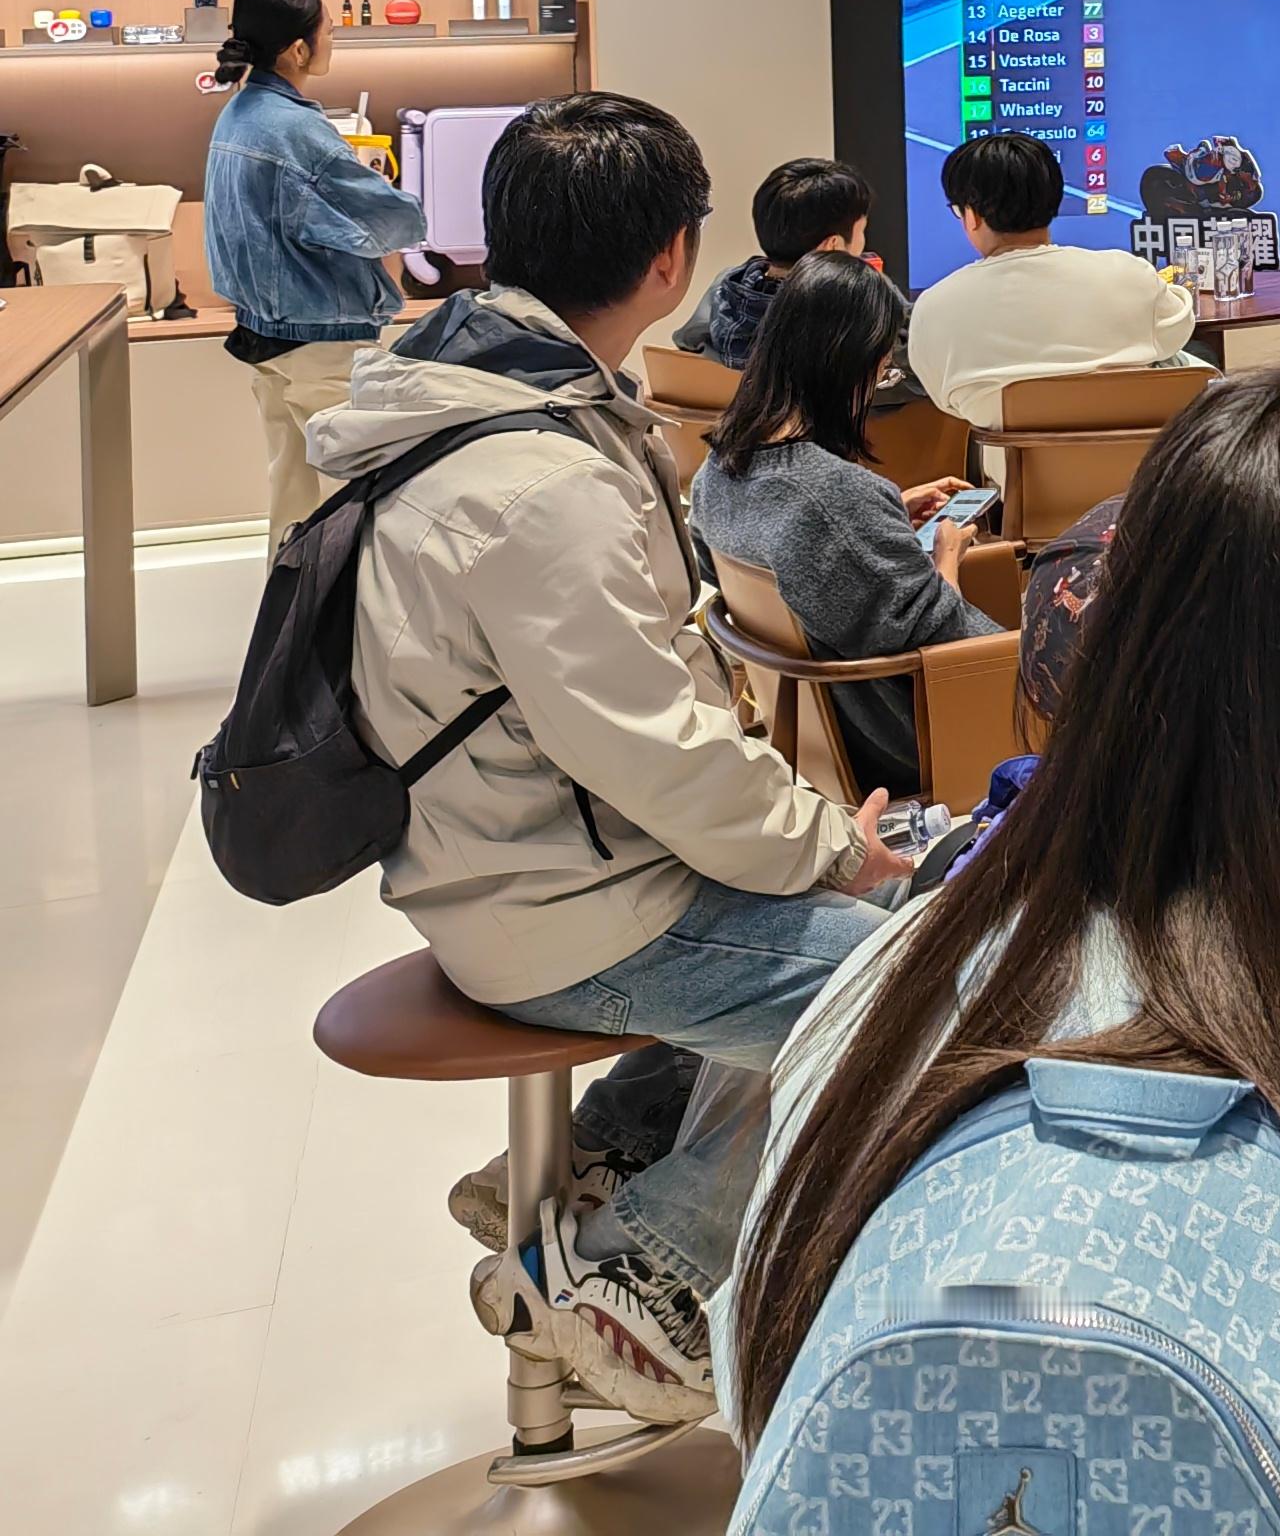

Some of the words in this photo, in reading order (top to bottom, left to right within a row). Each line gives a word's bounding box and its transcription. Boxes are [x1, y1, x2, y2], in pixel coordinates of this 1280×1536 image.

[967, 5, 986, 18] 13
[998, 5, 1064, 20] Aegerter
[1083, 3, 1102, 15] 77
[968, 30, 986, 43] 14
[999, 30, 1019, 43] De
[1024, 29, 1060, 42] Rosa
[1089, 28, 1098, 39] 3
[968, 55, 986, 68] 15
[999, 53, 1066, 67] Vostatek
[1000, 78, 1050, 92] Taccini
[1086, 77, 1103, 88] 10
[1000, 102, 1062, 117] Whatley
[1087, 101, 1104, 112] 70
[1087, 125, 1104, 136] 64
[1091, 149, 1101, 161] 6
[1089, 173, 1105, 185] 91
